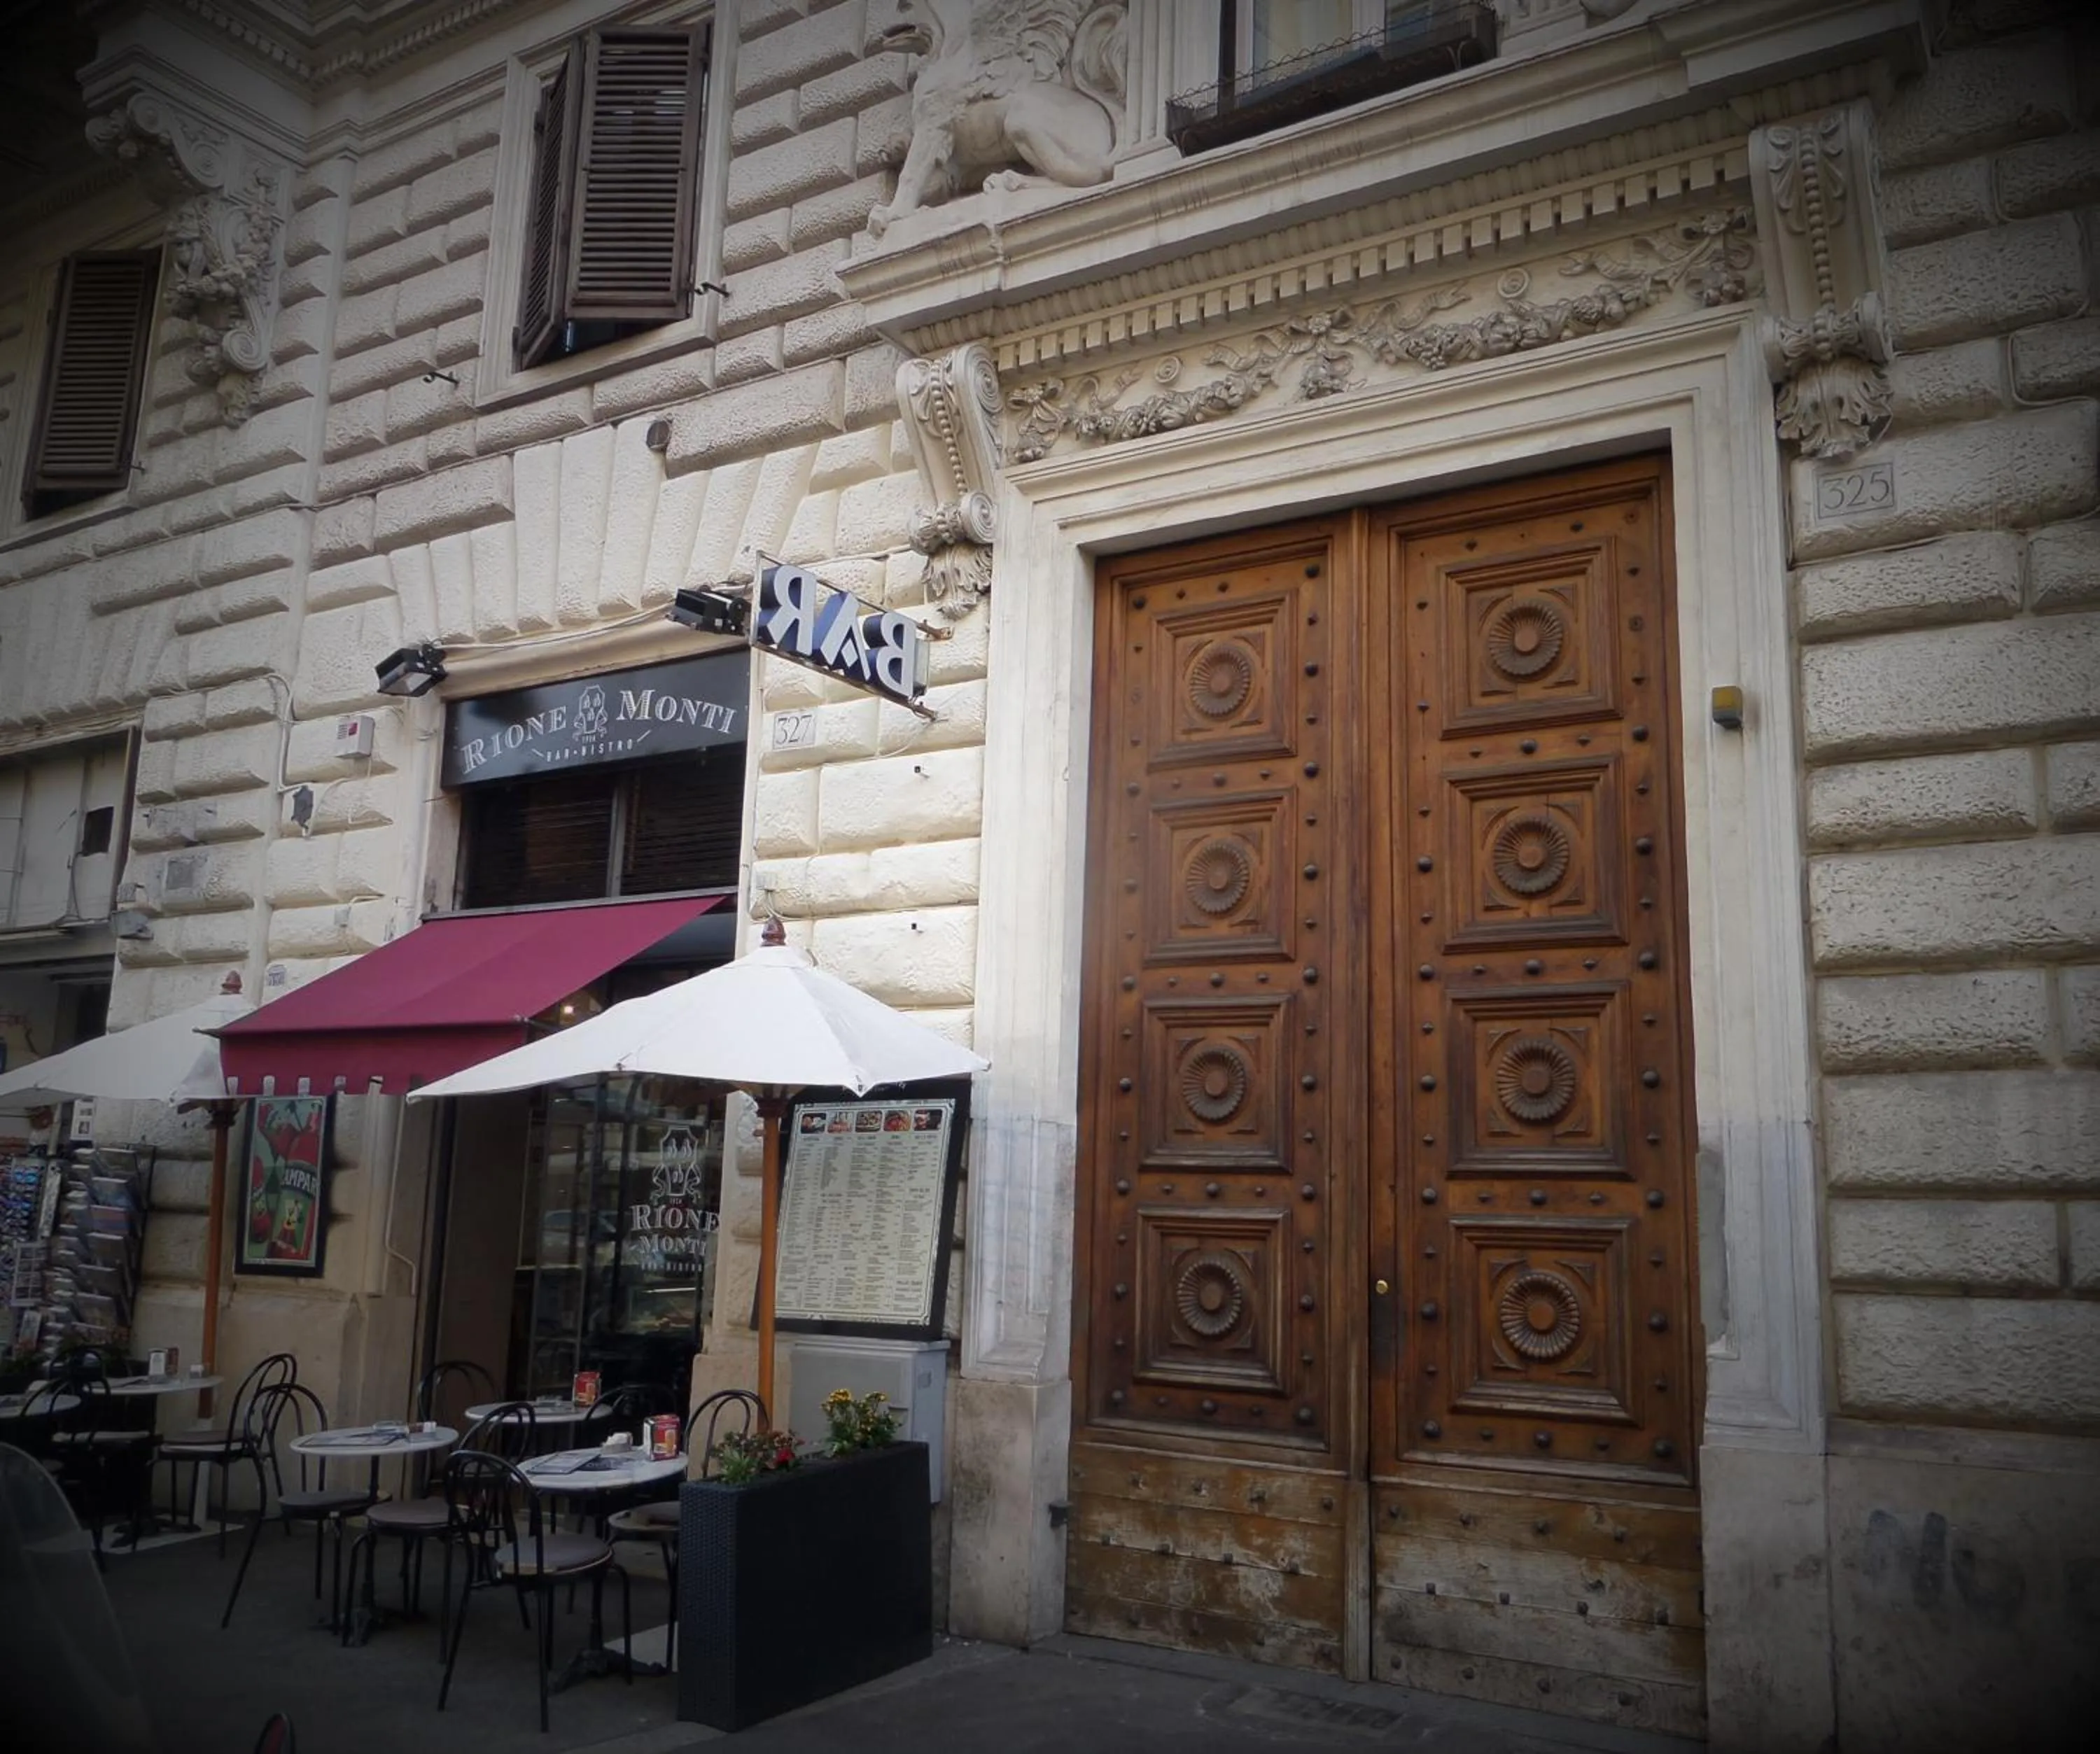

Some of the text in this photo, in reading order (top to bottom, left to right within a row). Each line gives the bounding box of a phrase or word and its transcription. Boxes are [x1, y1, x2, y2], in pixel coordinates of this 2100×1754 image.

[1823, 470, 1889, 510] 325
[461, 689, 737, 775] RIONE MONTI
[775, 715, 813, 744] 327
[630, 1204, 720, 1232] RIONE
[639, 1234, 706, 1257] MONTI
